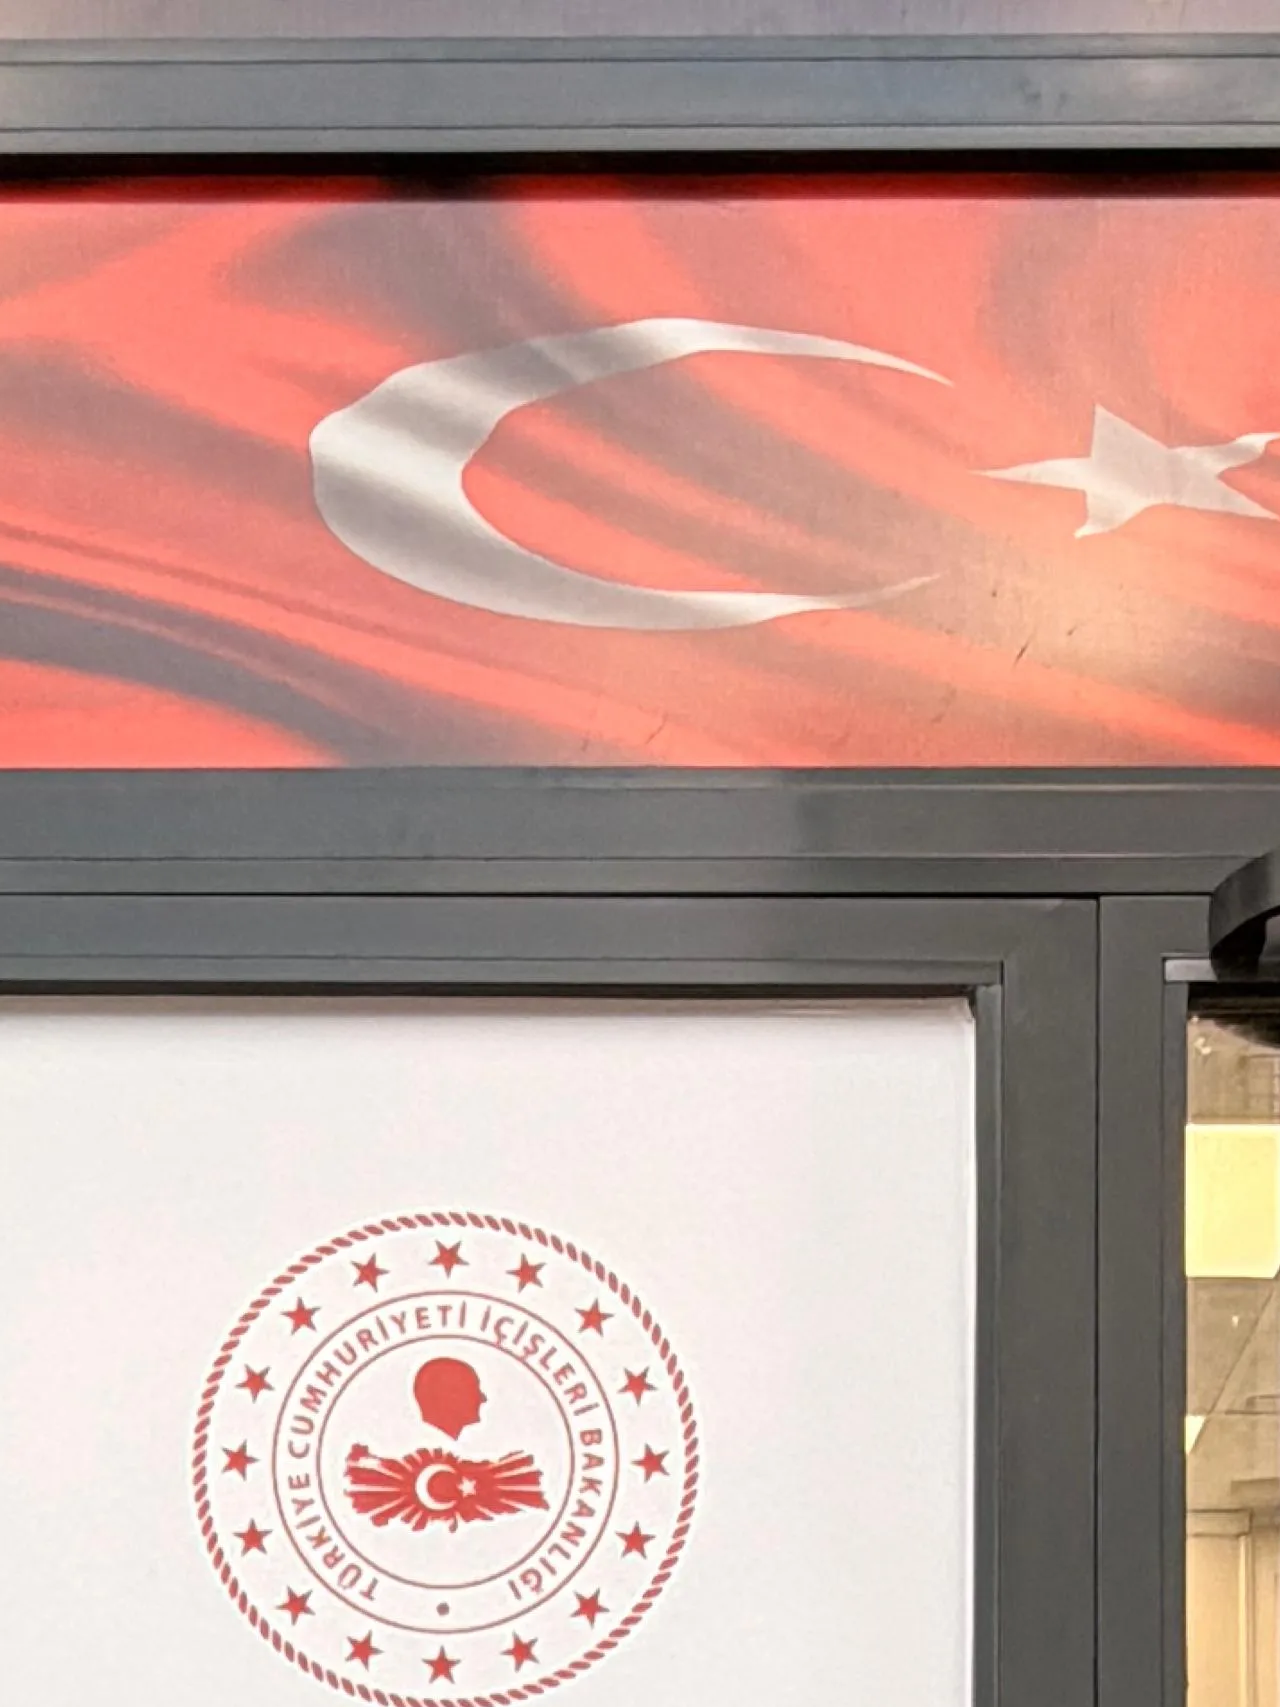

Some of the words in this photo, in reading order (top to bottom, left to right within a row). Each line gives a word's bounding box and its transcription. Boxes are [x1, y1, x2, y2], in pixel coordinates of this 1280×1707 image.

[290, 1303, 468, 1459] CUMHURİYETİ
[480, 1304, 601, 1419] İÇİŞLERİ
[288, 1473, 382, 1600] TÜRKİYE
[506, 1428, 603, 1602] BAKANLIĞI
